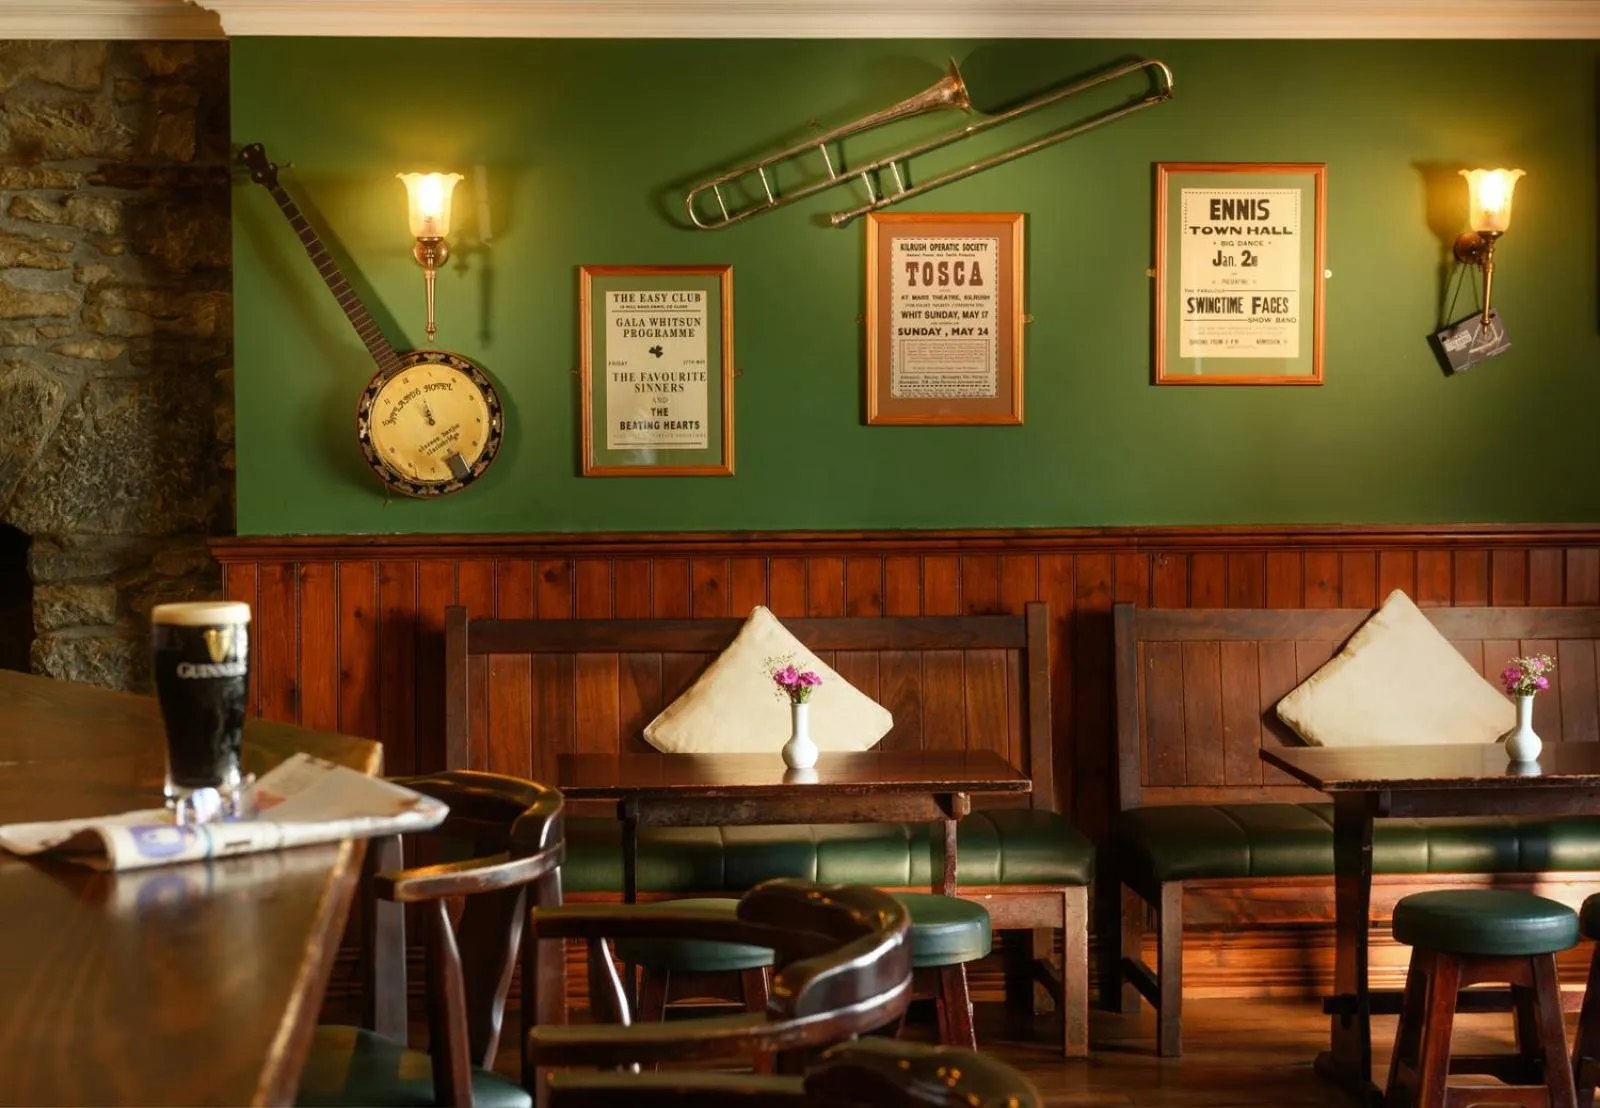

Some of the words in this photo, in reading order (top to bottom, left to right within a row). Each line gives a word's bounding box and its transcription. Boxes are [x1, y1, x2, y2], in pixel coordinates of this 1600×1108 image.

[1210, 198, 1270, 221] ENNIS
[1189, 226, 1242, 235] TOWN
[1247, 226, 1293, 235] HALL
[900, 243, 927, 251] KILRUSH
[930, 243, 959, 251] OPERATIC
[962, 243, 988, 251] SOCIETY
[1212, 249, 1237, 267] Jan.
[906, 261, 983, 287] TOSCA
[613, 293, 635, 302] THE
[640, 293, 668, 302] EASY
[671, 293, 701, 302] CLUB
[901, 311, 922, 319] WHIT
[924, 311, 960, 320] SUNDAY,
[962, 311, 979, 319] MAY
[616, 318, 646, 327] GALA
[650, 317, 701, 327] WHITSUN
[623, 328, 695, 338] PROGRAMME
[951, 328, 974, 336] MAY
[978, 328, 989, 336] 24
[613, 372, 636, 382] THE
[640, 372, 706, 382] FAVOURITE
[635, 383, 685, 393] SINNERS
[651, 407, 669, 417] THE
[620, 421, 660, 430] BEATING
[664, 420, 700, 430] HEARTS
[176, 662, 247, 679] GUINN
